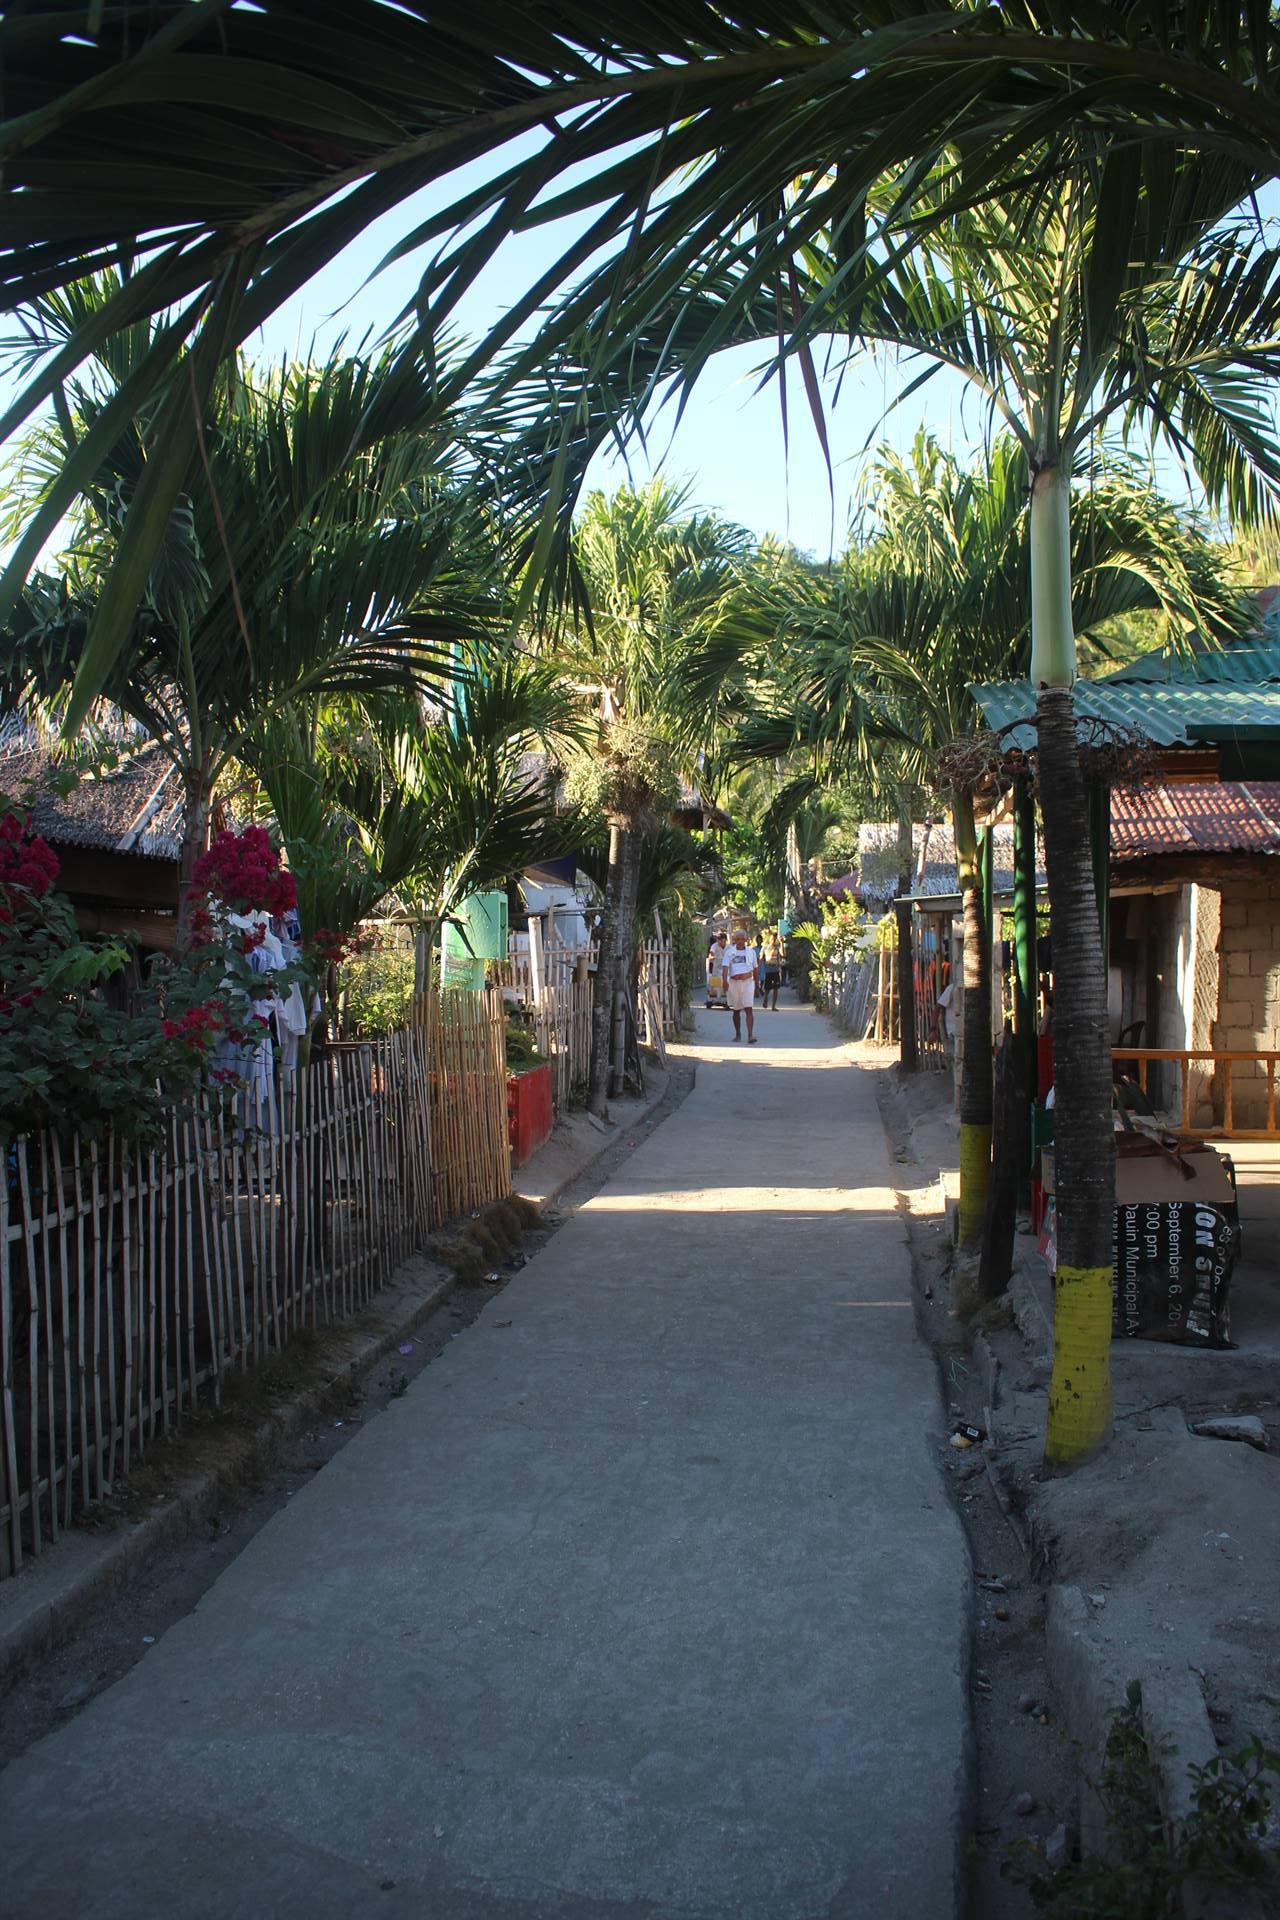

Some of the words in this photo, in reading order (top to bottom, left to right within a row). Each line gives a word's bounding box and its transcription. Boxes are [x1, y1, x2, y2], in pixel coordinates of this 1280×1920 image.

[1143, 1235, 1158, 1258] pm
[1166, 1202, 1182, 1281] September
[1123, 1247, 1140, 1315] Municipal
